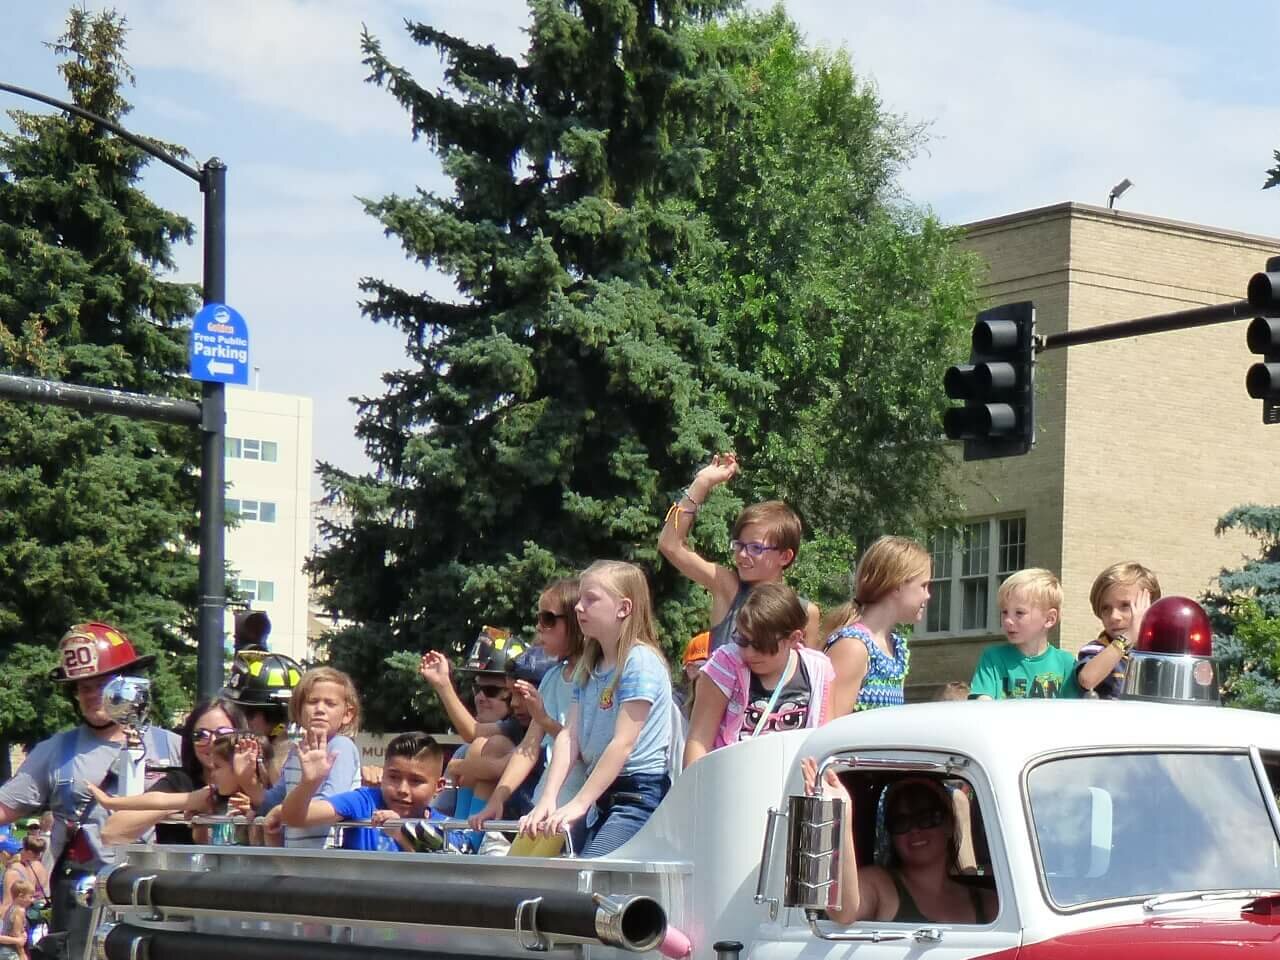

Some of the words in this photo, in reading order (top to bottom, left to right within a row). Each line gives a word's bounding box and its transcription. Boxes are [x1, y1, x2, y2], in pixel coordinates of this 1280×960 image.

[194, 332, 216, 343] Free
[217, 335, 247, 346] Public
[193, 341, 247, 364] Parking
[64, 646, 91, 668] 20
